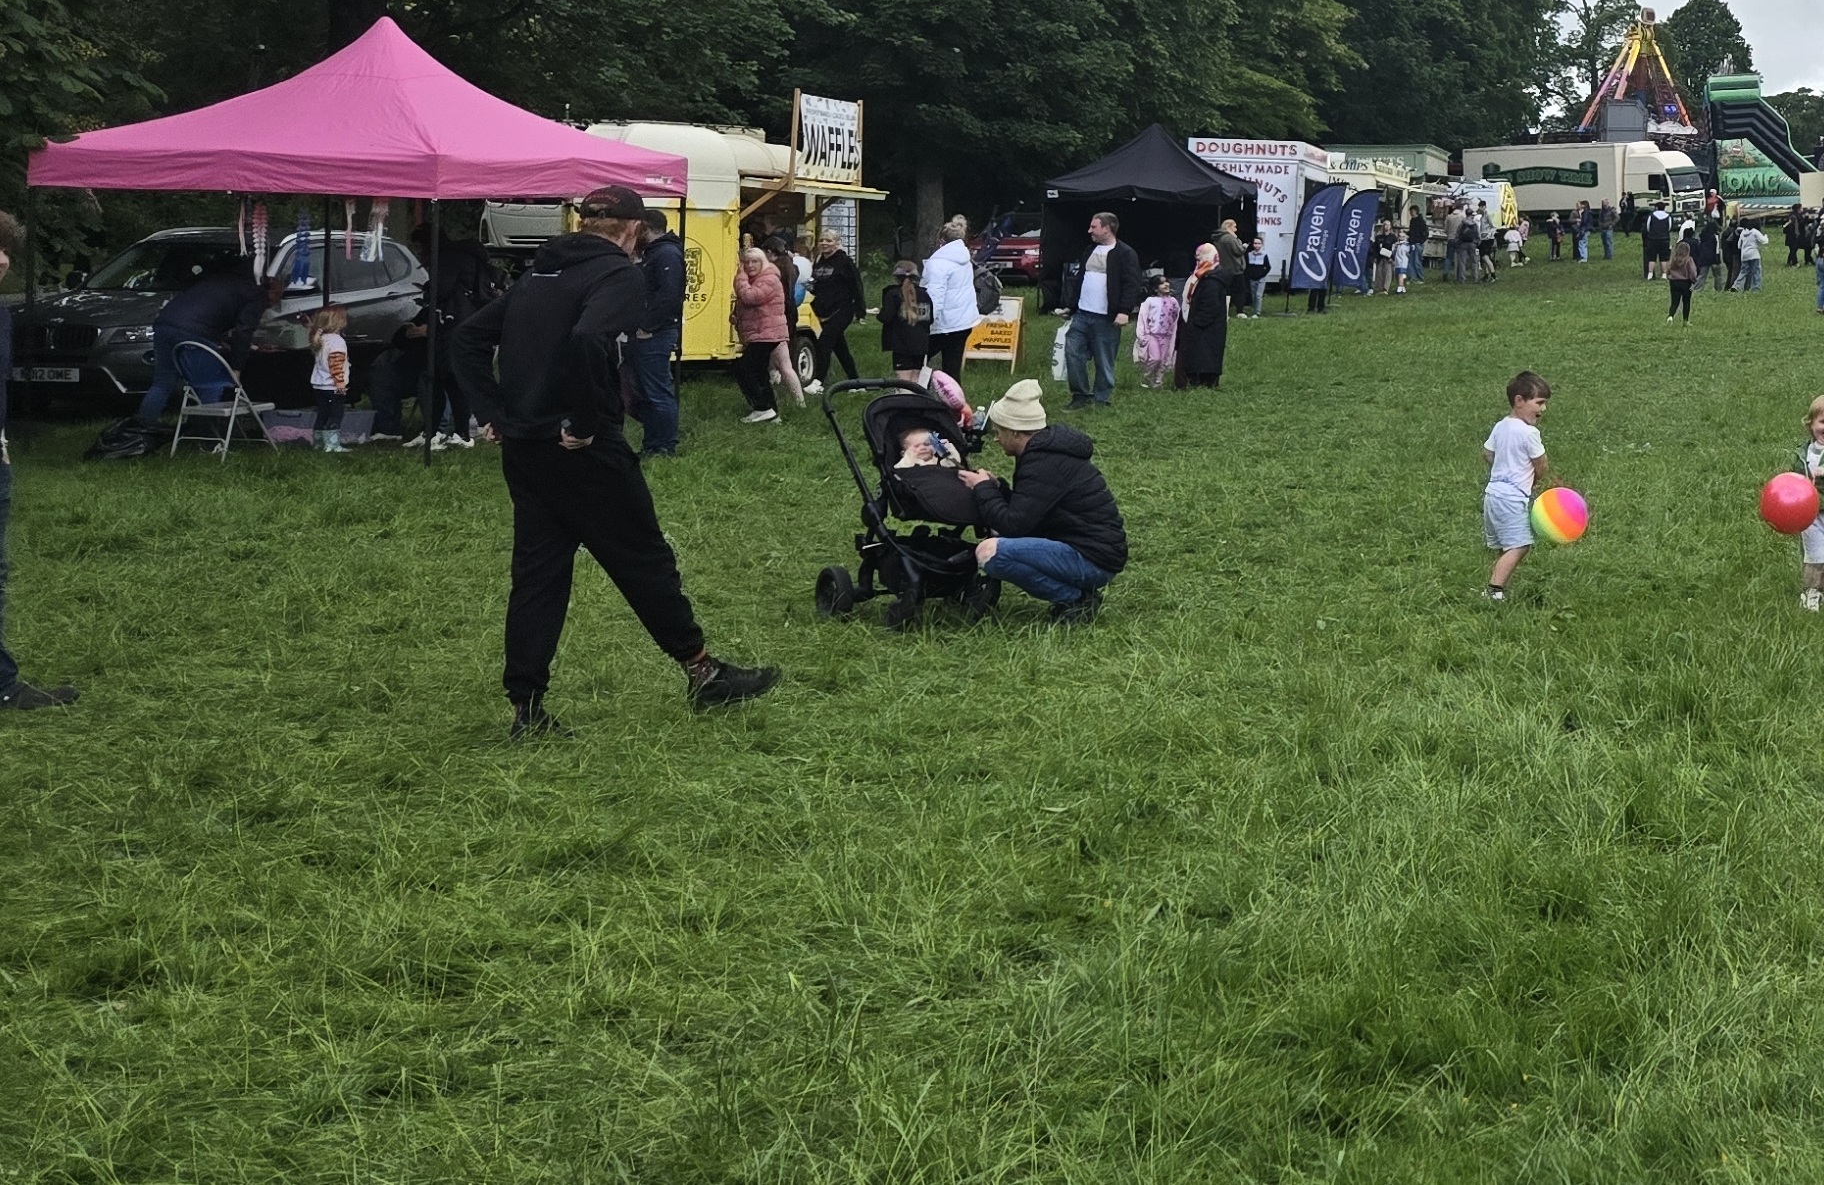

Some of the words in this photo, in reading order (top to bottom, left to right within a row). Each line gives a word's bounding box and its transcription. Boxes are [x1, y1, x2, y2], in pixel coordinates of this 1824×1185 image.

[803, 122, 860, 171] WAFFLES
[1195, 141, 1298, 156] DOUGHNUTS
[1254, 164, 1290, 175] MADE
[1329, 161, 1337, 170] &
[1339, 159, 1369, 171] CHIPS
[1516, 169, 1557, 183] SHOW
[1558, 170, 1593, 185] TIME
[1244, 176, 1288, 204] NUTS
[1298, 204, 1327, 282] Craven
[1338, 208, 1363, 280] Craven
